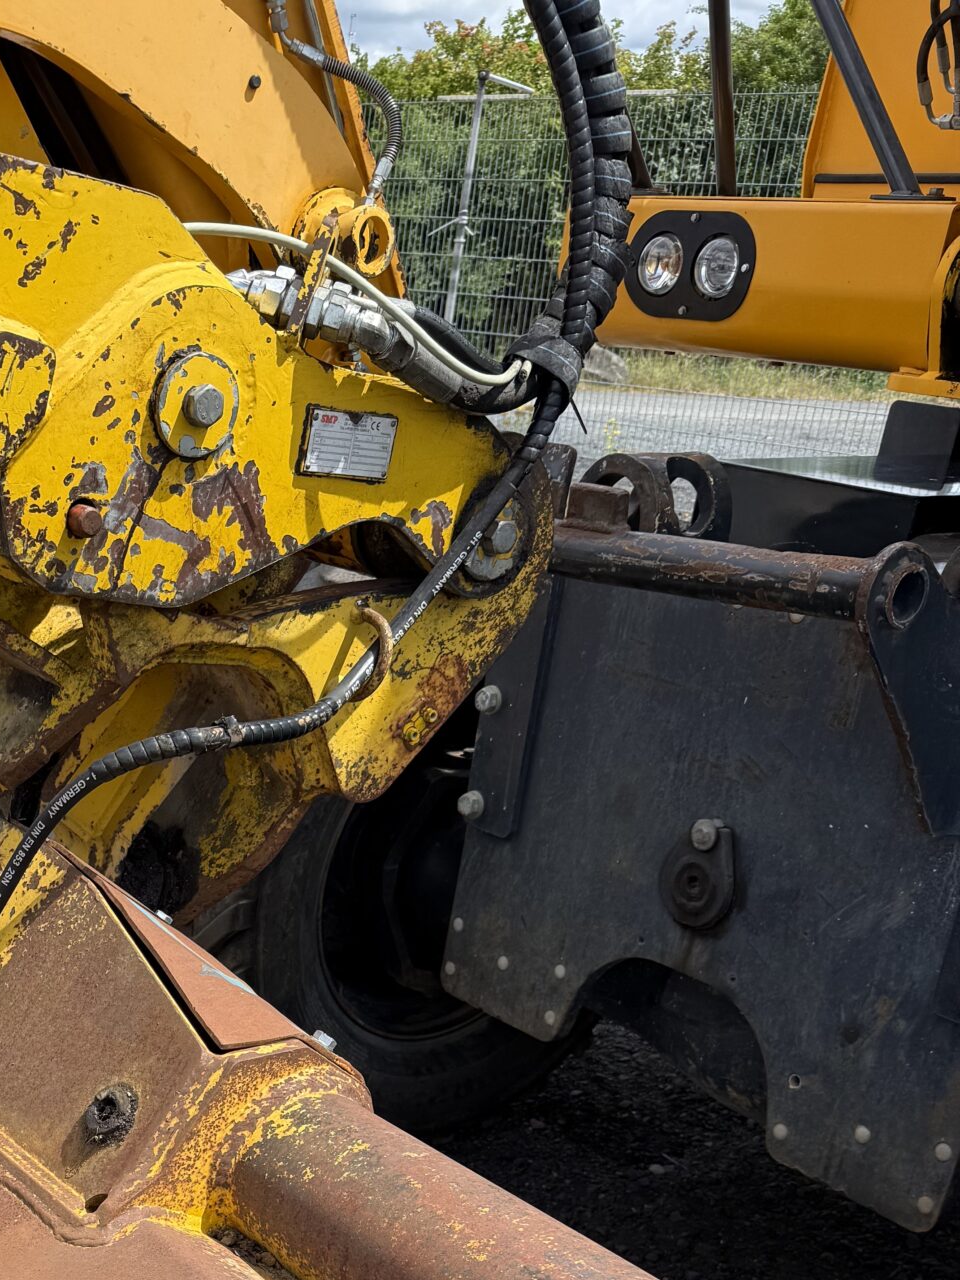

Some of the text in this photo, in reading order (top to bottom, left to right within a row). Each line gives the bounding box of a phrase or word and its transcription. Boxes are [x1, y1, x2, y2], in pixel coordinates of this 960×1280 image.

[470, 530, 483, 546] SH
[431, 551, 468, 597] GERMANY
[414, 600, 428, 618] DIN
[403, 616, 415, 631] EN
[48, 779, 86, 819] GERMANY
[31, 820, 46, 838] DIN
[22, 836, 35, 852] EN
[12, 850, 26, 867] 853
[1, 866, 15, 887] 2SN
